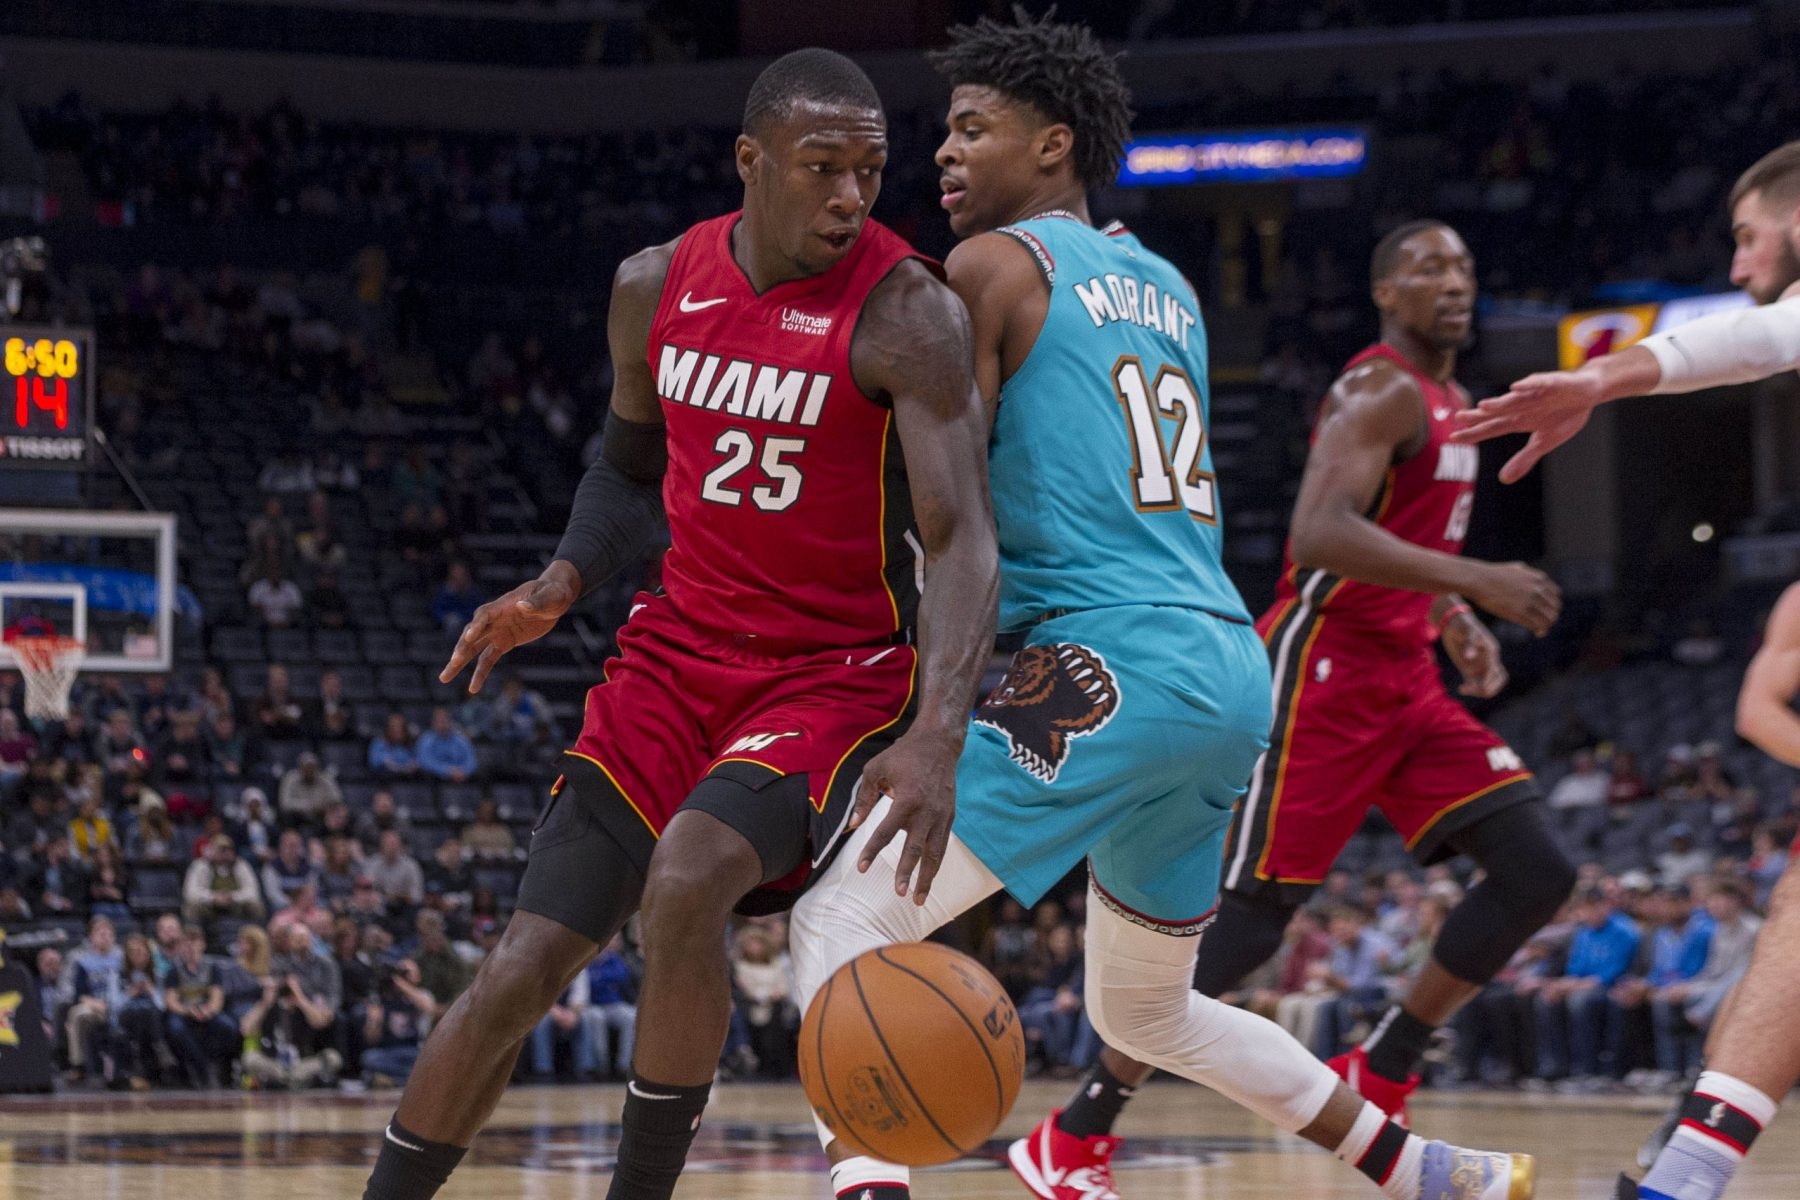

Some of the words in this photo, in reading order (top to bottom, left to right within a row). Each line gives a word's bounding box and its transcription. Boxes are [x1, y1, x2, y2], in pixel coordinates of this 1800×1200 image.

[781, 307, 832, 328] Ultimate
[781, 322, 828, 336] SOFTWARE
[1074, 274, 1194, 351] MORANT
[5, 337, 77, 377] 6:50
[16, 376, 67, 428] 14
[658, 344, 831, 426] MIAMI
[9, 437, 83, 459] TISSOT
[1111, 355, 1217, 527] 12
[700, 427, 808, 513] 25
